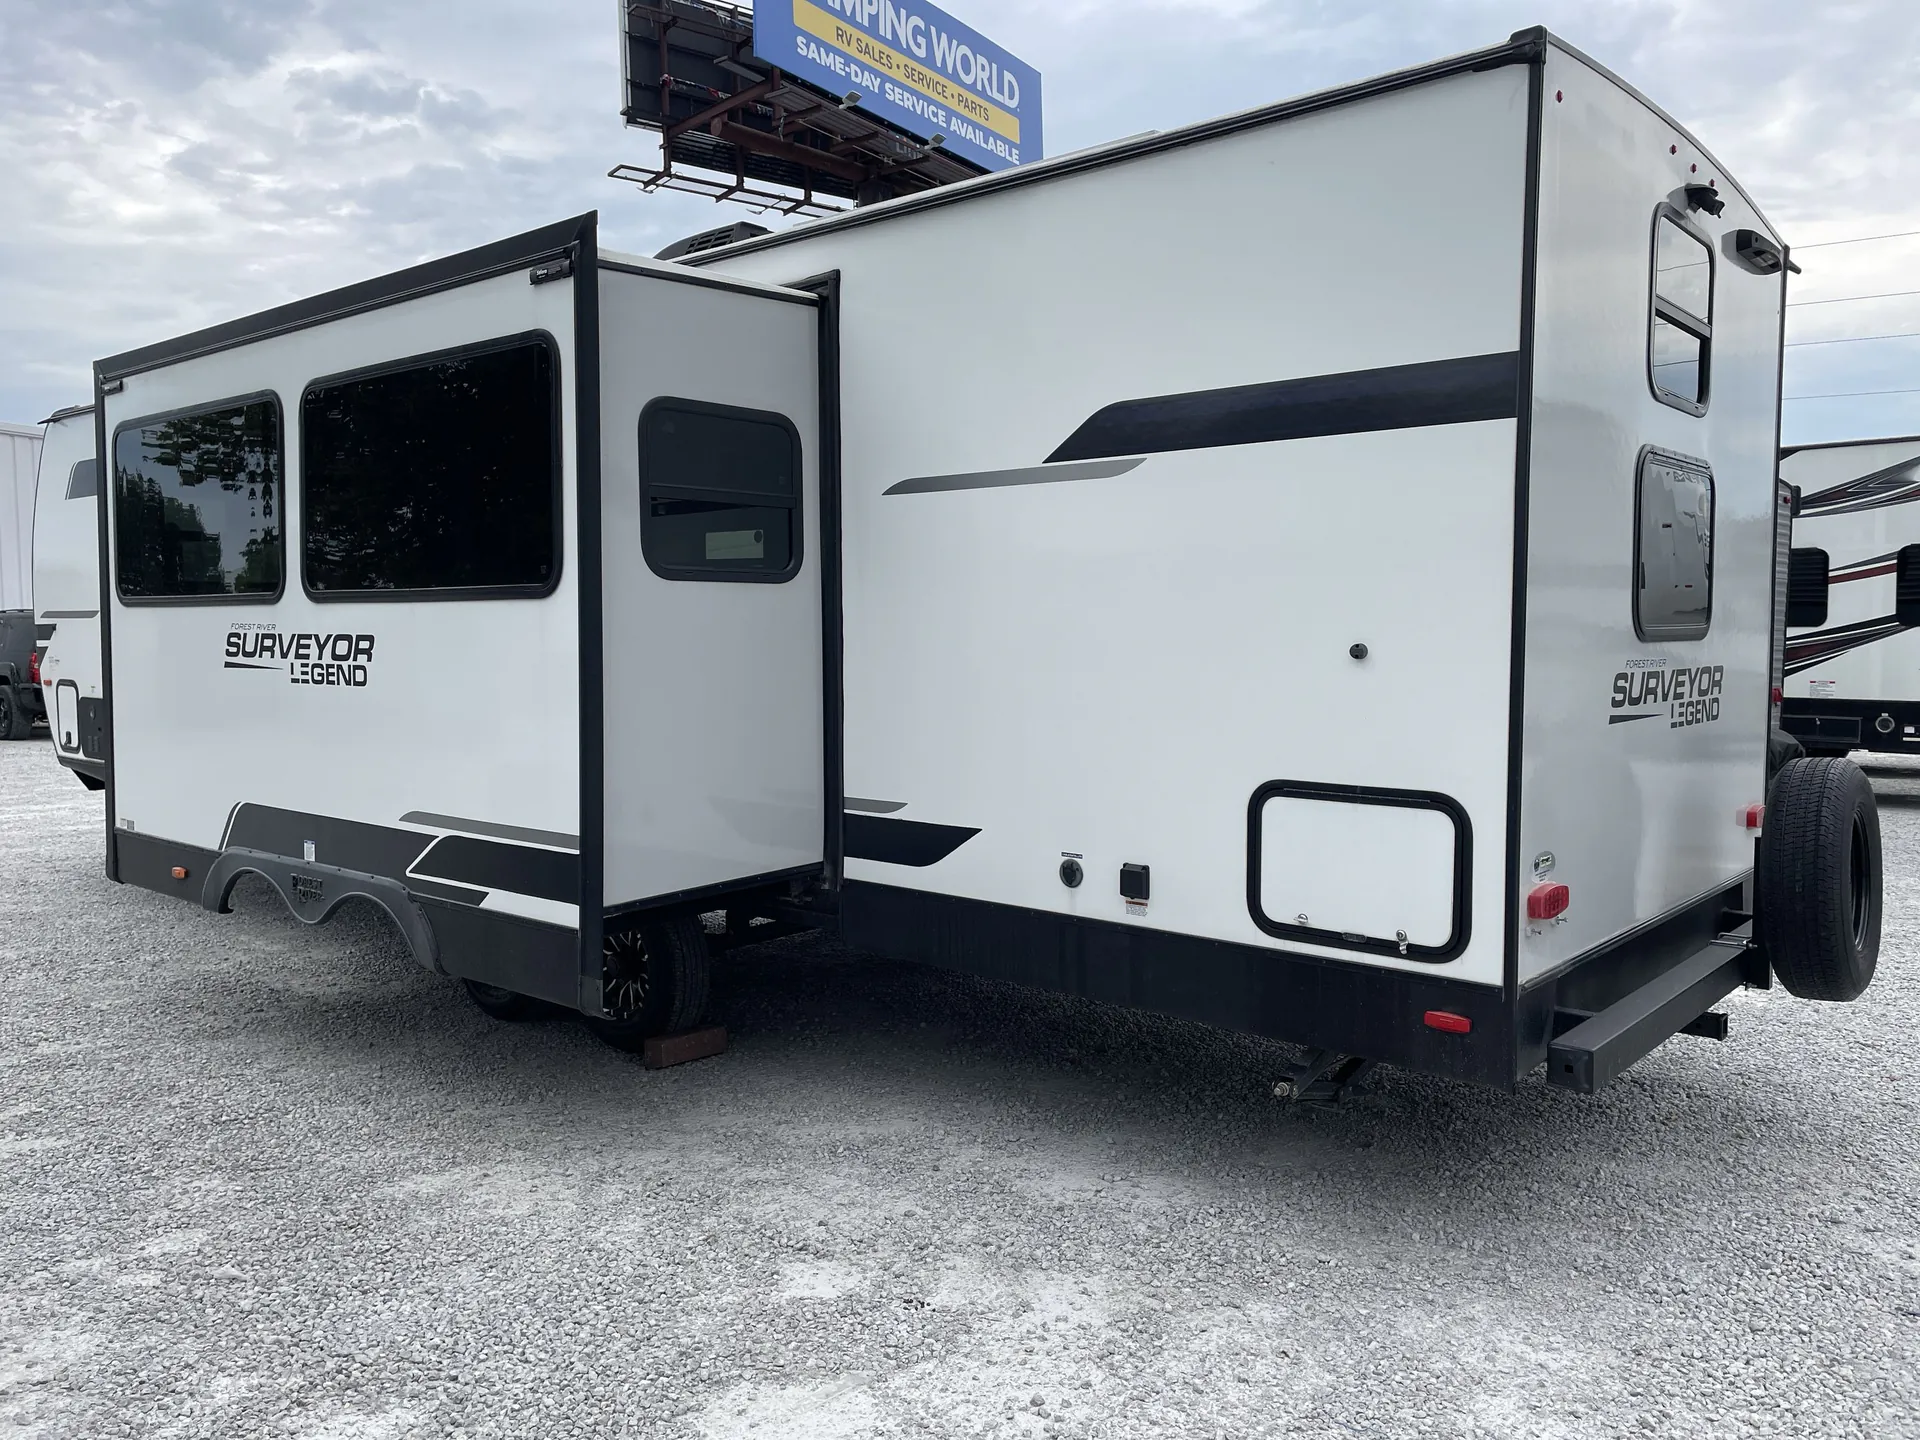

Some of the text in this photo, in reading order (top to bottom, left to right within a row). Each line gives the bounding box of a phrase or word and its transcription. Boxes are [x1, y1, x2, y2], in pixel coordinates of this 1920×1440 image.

[836, 26, 989, 122] RV SALES SERVICE PARTS
[930, 25, 1020, 109] WORLD
[796, 35, 1020, 166] SAME-DAY SERVICE AVAILABLE
[231, 623, 256, 631] FOREST
[225, 632, 375, 662] SURVEYOR
[290, 662, 368, 687] LEGEND
[1625, 659, 1666, 668] FOREST RIVER
[1610, 665, 1724, 708] SURVEYOR
[1670, 697, 1720, 729] LEGEND
